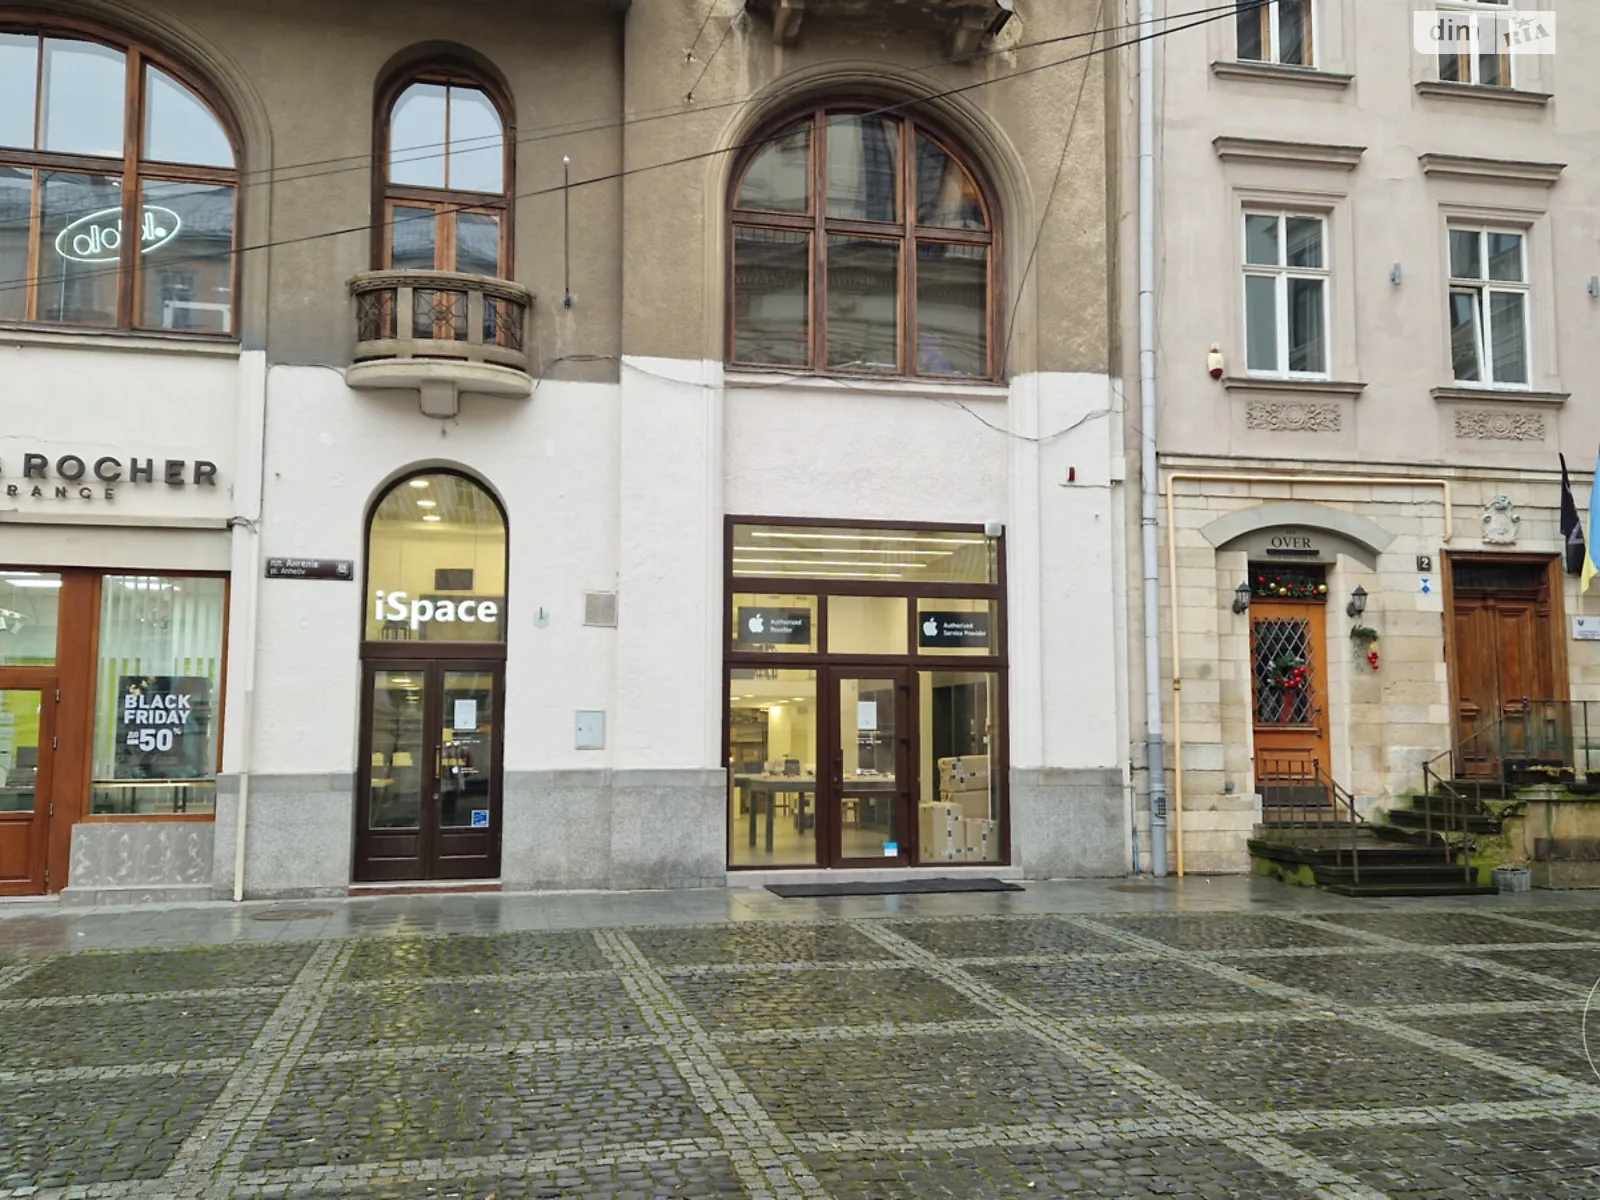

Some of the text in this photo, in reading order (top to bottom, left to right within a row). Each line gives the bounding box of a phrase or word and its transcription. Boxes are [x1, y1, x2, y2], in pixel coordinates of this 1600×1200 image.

[23, 453, 218, 486] ROCHER
[1271, 536, 1312, 549] OVER
[1421, 557, 1429, 568] 2
[375, 590, 498, 630] iSpace
[125, 694, 191, 709] BLACK
[124, 709, 191, 724] FRIDAY
